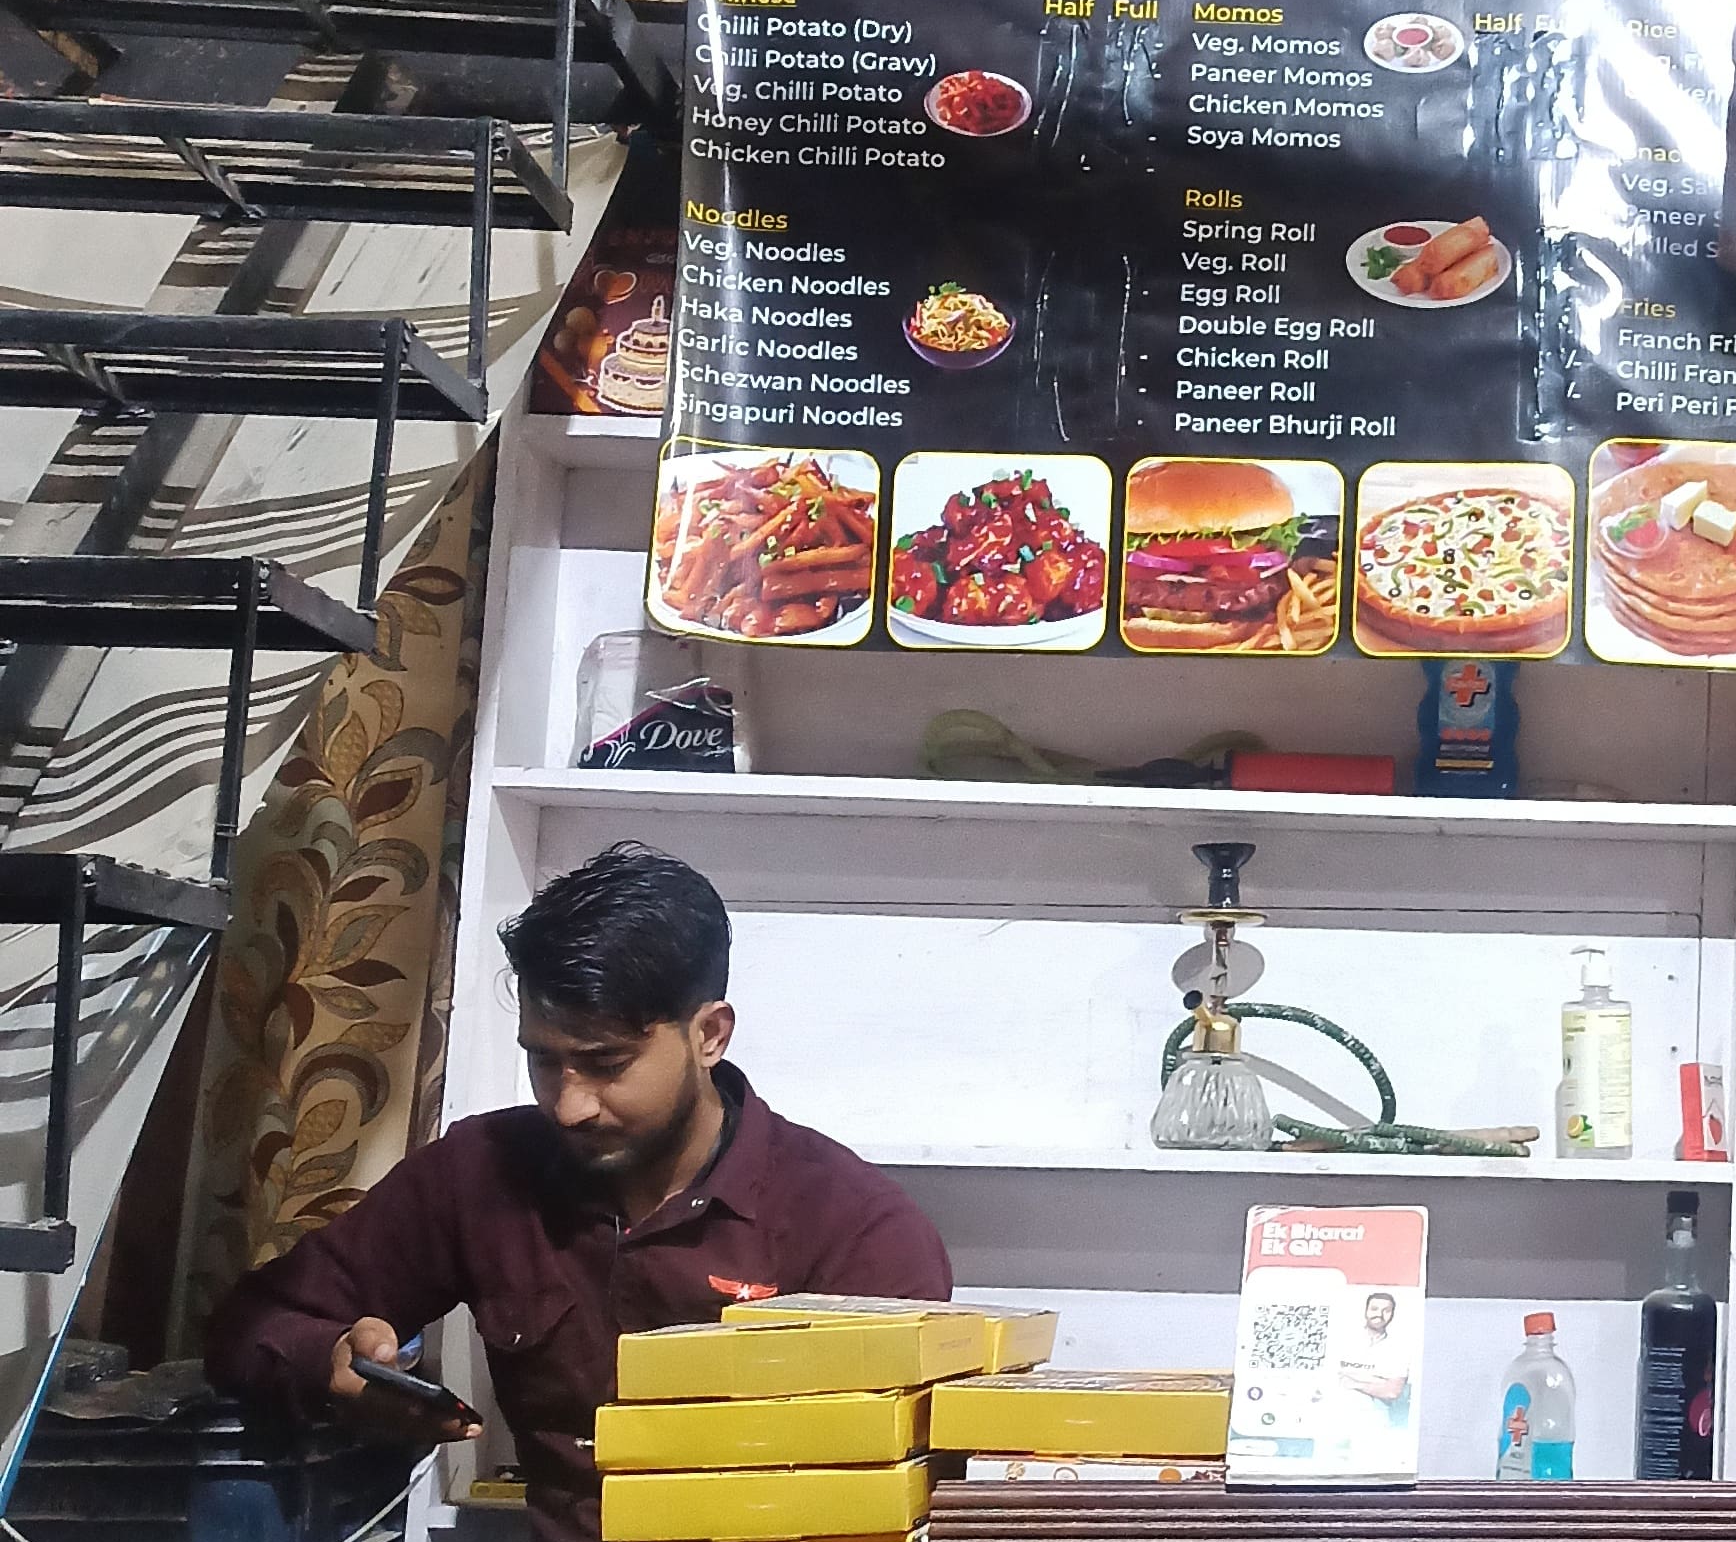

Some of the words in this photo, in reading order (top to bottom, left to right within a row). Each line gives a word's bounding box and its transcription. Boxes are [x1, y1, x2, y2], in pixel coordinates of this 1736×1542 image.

[1115, 0, 1158, 19] Full
[1195, 3, 1283, 22] Momos
[698, 15, 759, 35] Chilli
[767, 18, 847, 38] Potato
[854, 20, 912, 43] (Dry)
[1474, 13, 1523, 32] Half
[1193, 33, 1244, 57] Veg.
[1253, 35, 1340, 56] Momos
[696, 45, 758, 68] Chilli
[765, 49, 847, 70] Potato
[853, 50, 936, 76] (Gravy)
[1191, 65, 1276, 86] Paneer
[1284, 66, 1372, 87] Momos
[1189, 95, 1287, 116] Chicken
[1296, 97, 1384, 118] Momos
[690, 139, 789, 164] Chicken
[798, 145, 858, 166] Chilli
[865, 147, 945, 168] Potato
[1185, 189, 1243, 208] Rolls
[686, 200, 788, 229] Noodles
[1183, 221, 1261, 243] Spring
[1271, 223, 1315, 241] Roll
[684, 231, 736, 260] Veg.
[746, 242, 845, 262] Noodles
[683, 265, 783, 293] Chicken
[792, 275, 890, 296] Noodles
[681, 297, 743, 323] Haka
[752, 307, 852, 328] Noodles
[1620, 299, 1676, 319] Fries
[1179, 316, 1267, 335] Double
[1275, 318, 1320, 340] Egg
[1329, 319, 1374, 337] Roll
[1618, 331, 1701, 352] Franch
[1177, 348, 1275, 368] Chicken
[1284, 350, 1329, 369] Roll
[1617, 362, 1677, 382] Chilli
[1616, 393, 1664, 412] Peri
[1671, 397, 1718, 416] Peri
[1175, 413, 1261, 433] Paneer
[1269, 414, 1342, 440] Bhurji
[1351, 416, 1395, 435] Roll
[641, 722, 723, 751] Dove
[1291, 1224, 1364, 1240] Bharat
